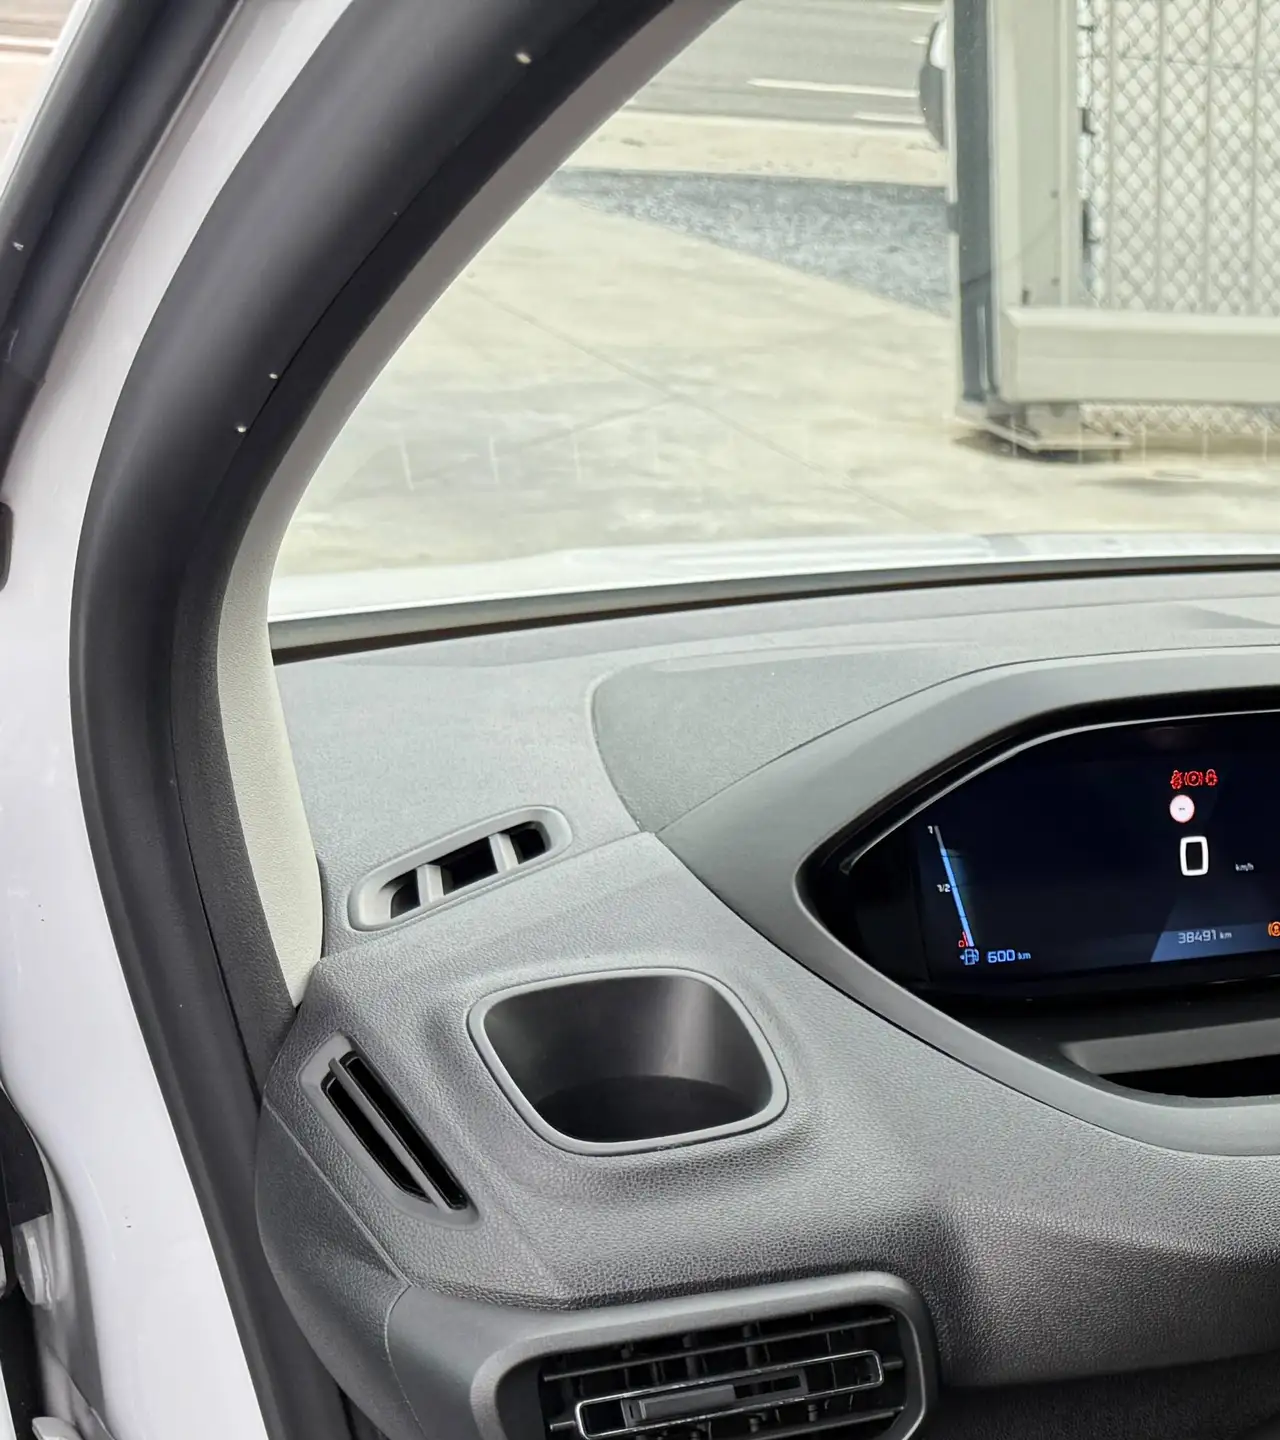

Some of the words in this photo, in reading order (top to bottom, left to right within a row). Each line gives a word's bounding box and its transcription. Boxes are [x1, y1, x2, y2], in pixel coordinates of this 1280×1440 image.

[1180, 836, 1209, 876] 0
[1235, 861, 1254, 872] km/h
[1178, 929, 1217, 944] 38491
[1219, 931, 1232, 940] km
[987, 949, 1016, 963] 600
[1017, 952, 1031, 960] km
